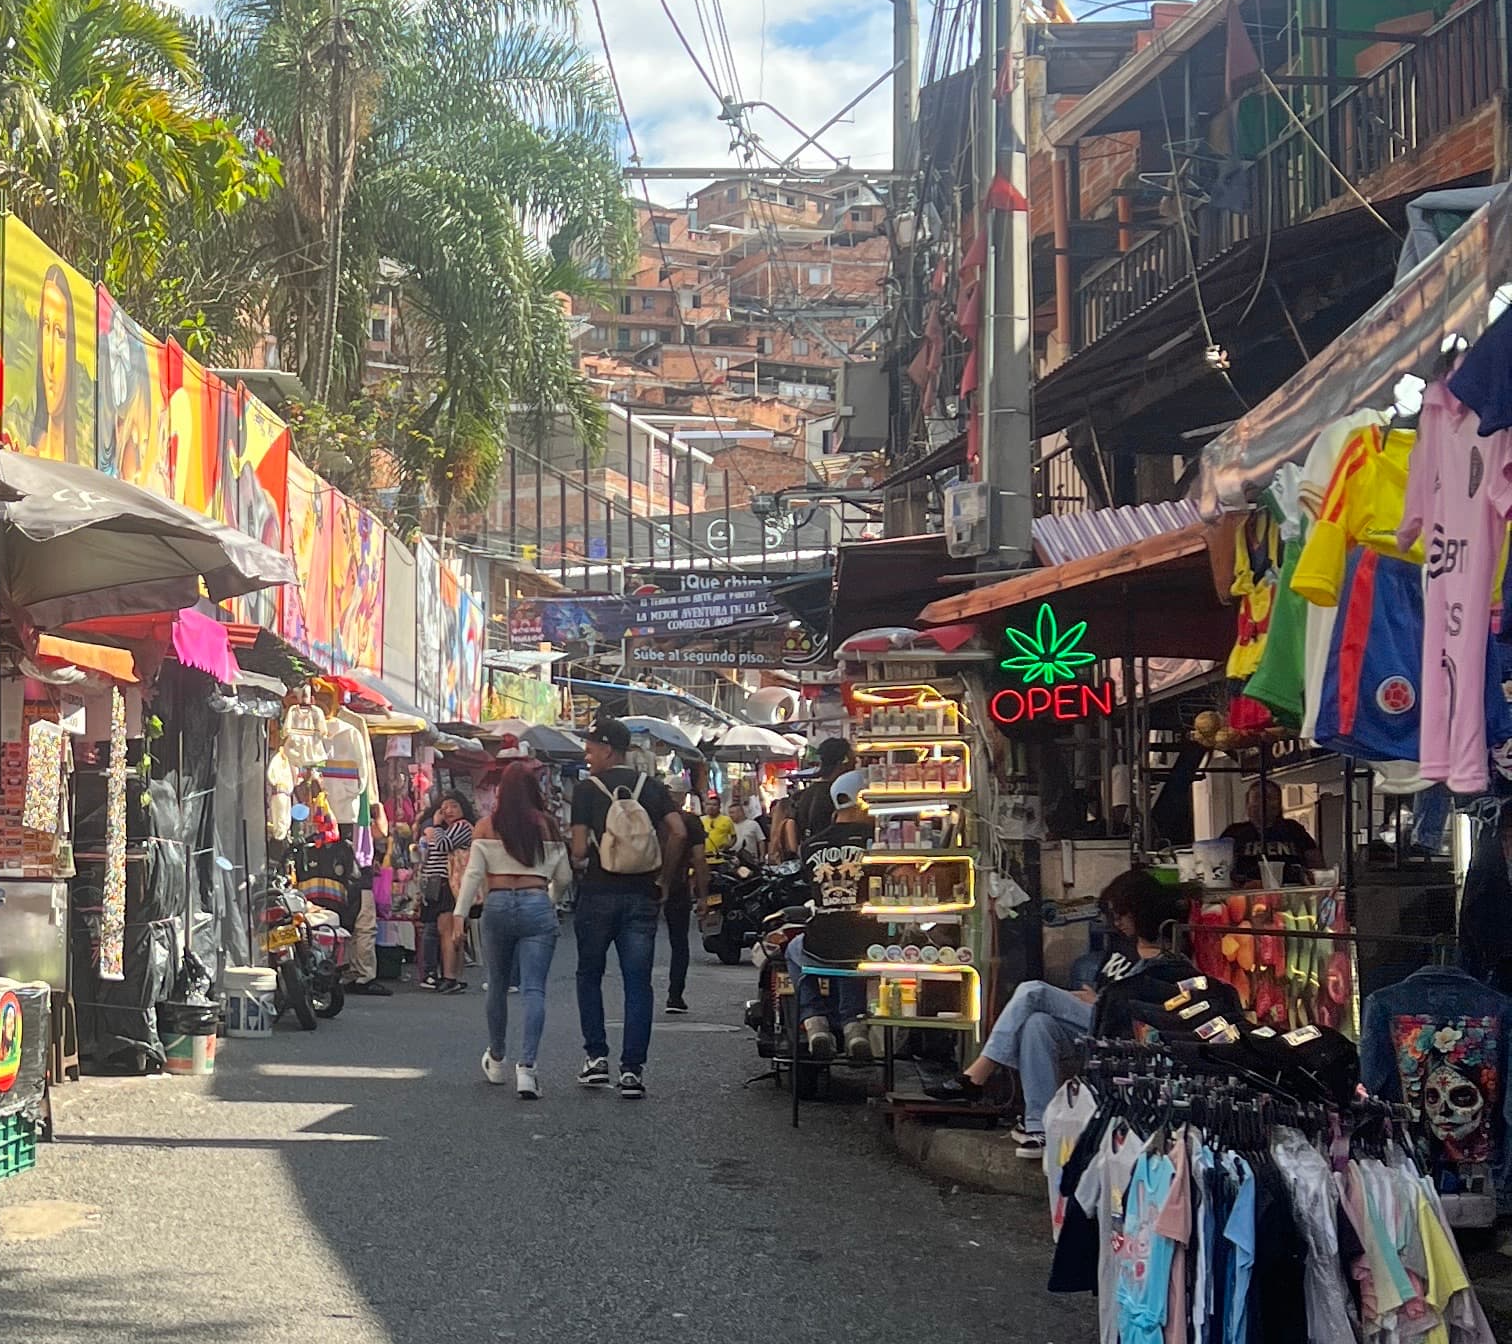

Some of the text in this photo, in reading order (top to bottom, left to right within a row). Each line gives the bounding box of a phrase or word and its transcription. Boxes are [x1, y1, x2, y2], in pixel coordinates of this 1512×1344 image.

[681, 604, 728, 620] AVENTURA
[634, 647, 665, 662] Sube
[668, 648, 680, 662] al
[683, 649, 736, 665] segundo
[991, 681, 1112, 724] OPEN
